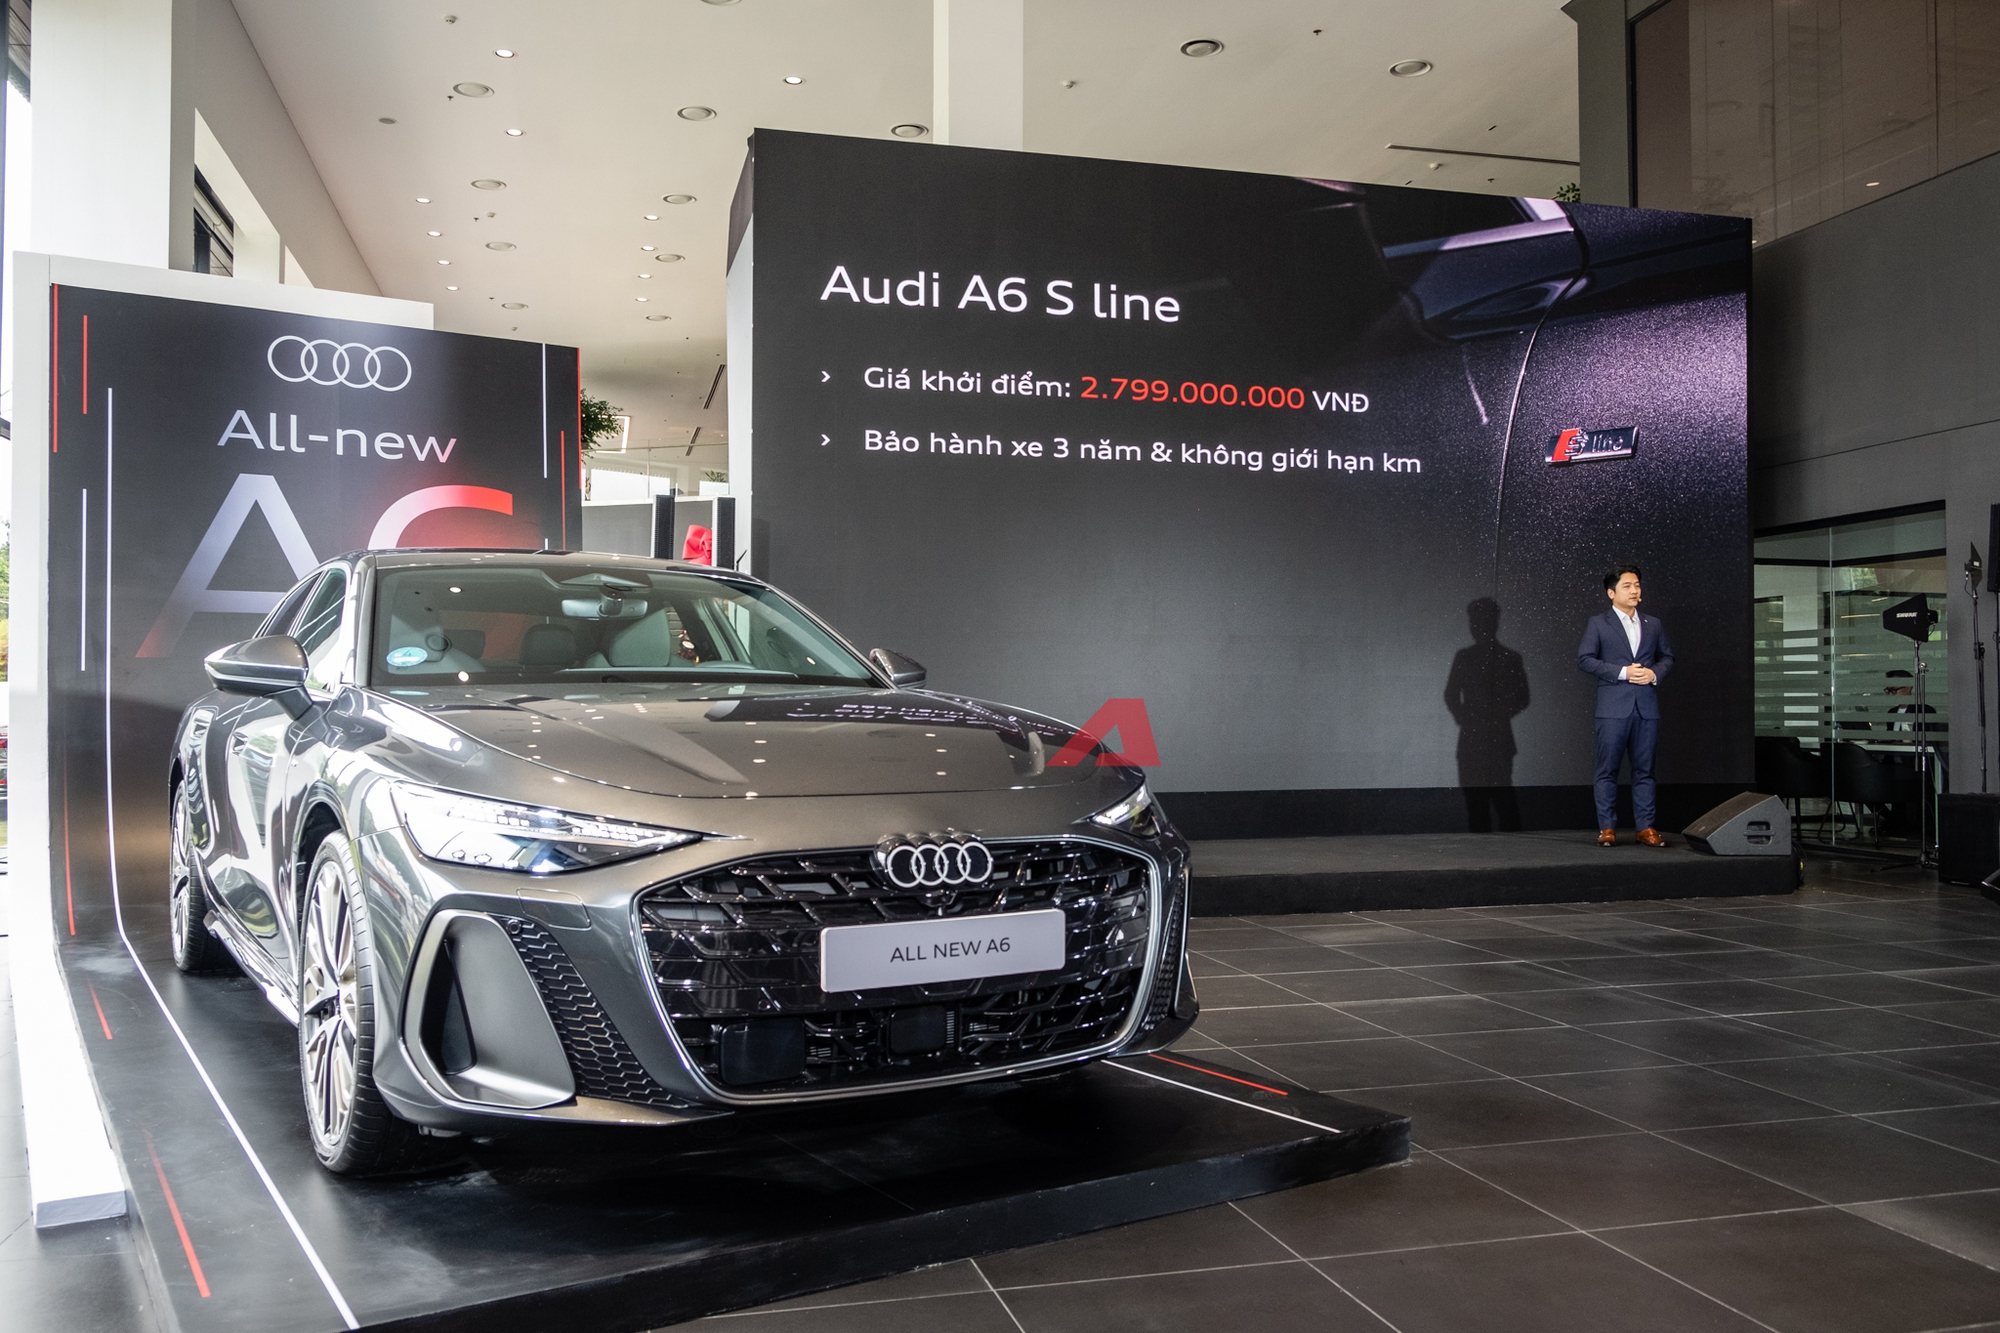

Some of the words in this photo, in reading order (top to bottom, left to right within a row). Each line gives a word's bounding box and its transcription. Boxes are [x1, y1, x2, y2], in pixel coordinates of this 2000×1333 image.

[820, 265, 940, 309] Audi
[957, 274, 1028, 313] A6
[1045, 279, 1074, 316] S
[1093, 282, 1181, 323] line
[863, 366, 911, 390] Giá
[922, 369, 982, 394] khởi
[991, 371, 1071, 398] điểm:
[1080, 376, 1305, 410] 2.799.000.000
[1312, 390, 1370, 413] VNĐ
[216, 409, 457, 463] All-new
[864, 429, 920, 453] Bảo
[930, 431, 1002, 456] hành
[1011, 440, 1043, 458] xe
[1053, 437, 1070, 459] 3
[1080, 438, 1142, 462] năm
[1151, 441, 1173, 463] &
[1182, 442, 1263, 472] không
[1271, 447, 1318, 473] giới
[1327, 449, 1374, 475] hạn
[1383, 452, 1421, 474] km
[890, 945, 927, 963] ALL
[933, 940, 982, 959] NEW
[986, 937, 1011, 954] A6
